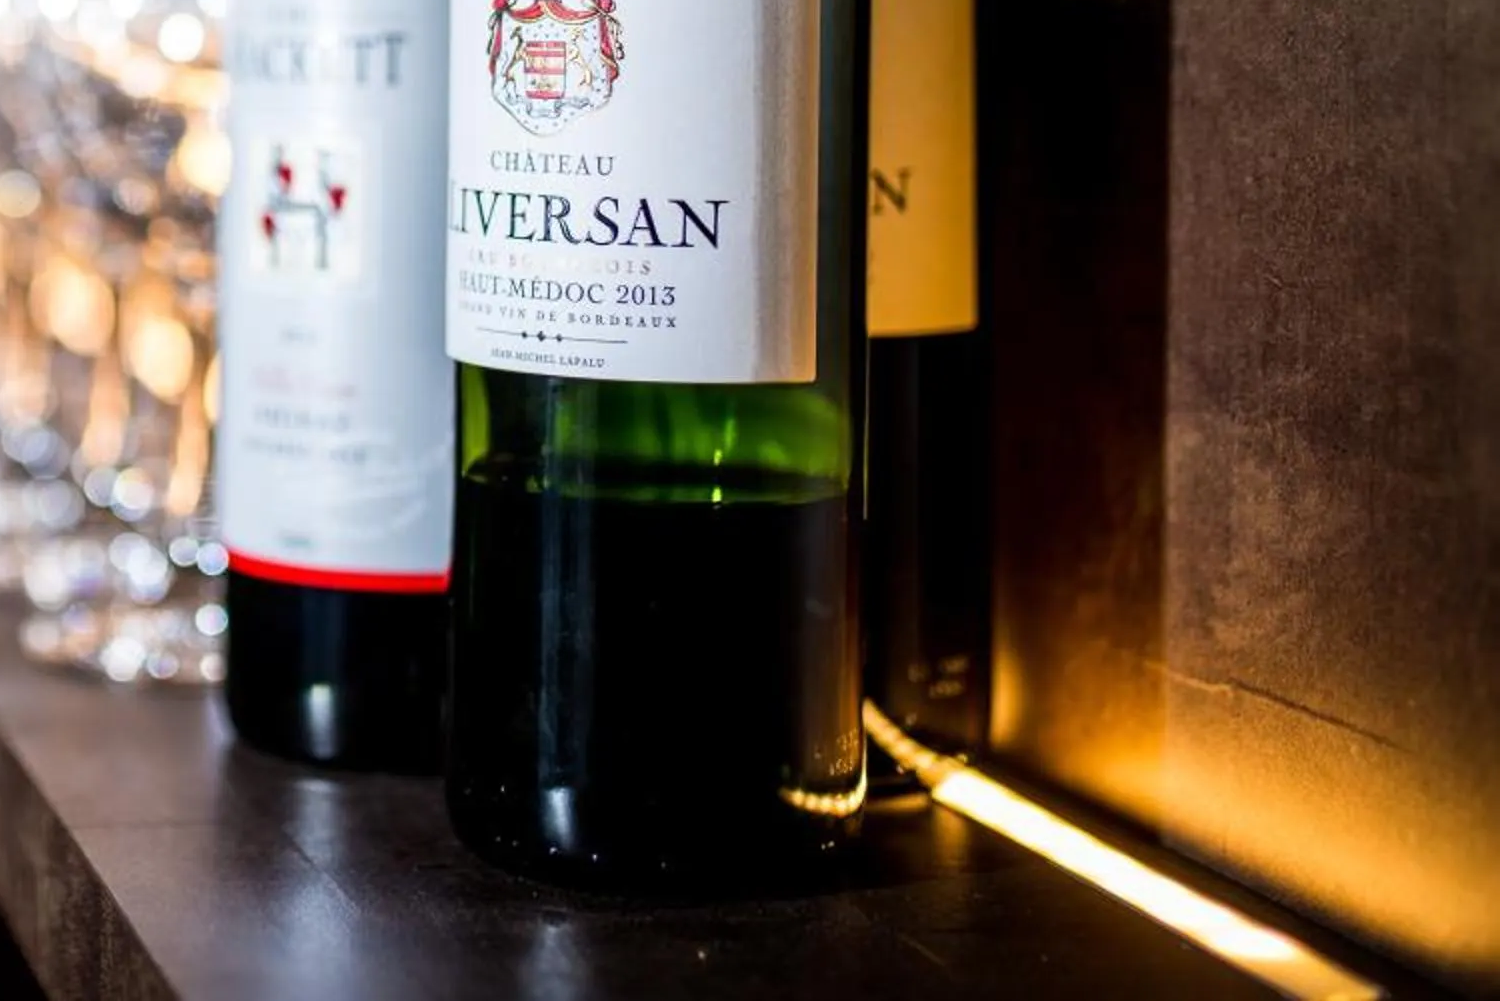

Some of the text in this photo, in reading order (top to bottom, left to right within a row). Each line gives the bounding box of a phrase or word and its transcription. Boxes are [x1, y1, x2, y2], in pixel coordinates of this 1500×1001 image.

[489, 148, 616, 176] CHÂTEAU
[615, 284, 677, 306] 2013
[500, 305, 527, 320] VIN
[536, 309, 558, 323] DE
[567, 312, 677, 329] BORDEAUX
